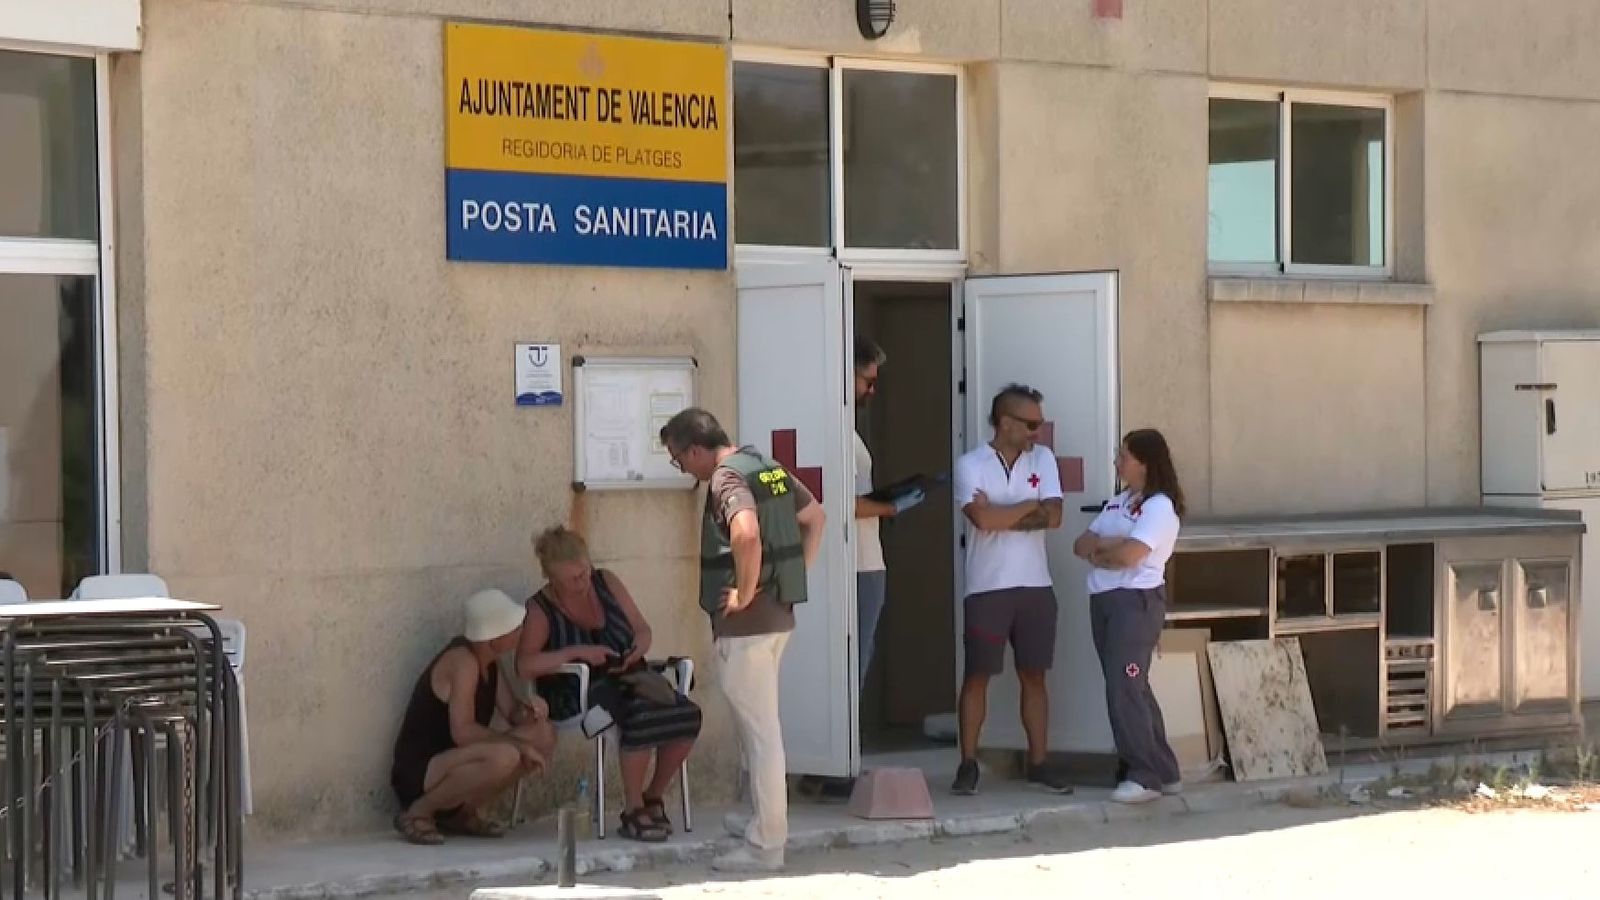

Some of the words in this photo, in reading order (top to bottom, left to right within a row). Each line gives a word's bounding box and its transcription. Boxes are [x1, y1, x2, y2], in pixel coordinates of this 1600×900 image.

[459, 77, 591, 122] AJUNTAMENT
[597, 87, 622, 124] DE
[628, 89, 718, 131] VALENCIA
[502, 138, 588, 161] REGIDORIA
[592, 144, 613, 163] DE
[616, 146, 682, 169] PLATGES
[461, 199, 557, 234] POSTA
[574, 205, 718, 240] SANITARIA
